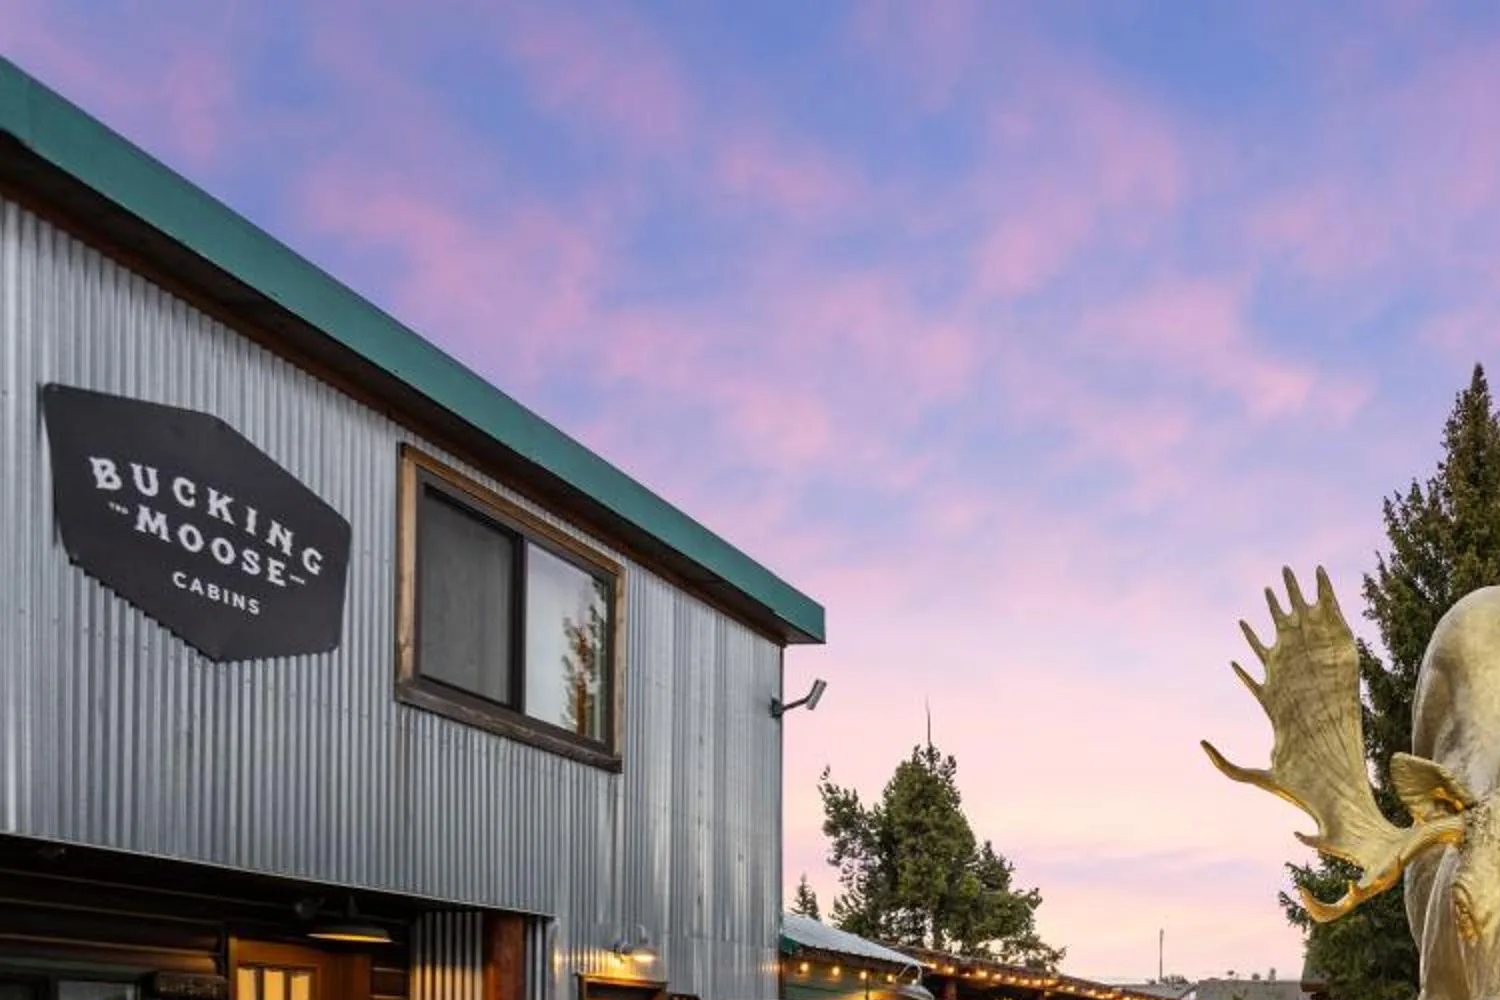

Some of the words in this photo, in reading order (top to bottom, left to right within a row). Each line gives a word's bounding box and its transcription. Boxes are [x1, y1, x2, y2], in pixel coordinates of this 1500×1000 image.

[89, 456, 323, 575] BUCKING
[135, 505, 287, 587] MOOSE
[172, 571, 260, 615] CABINS
